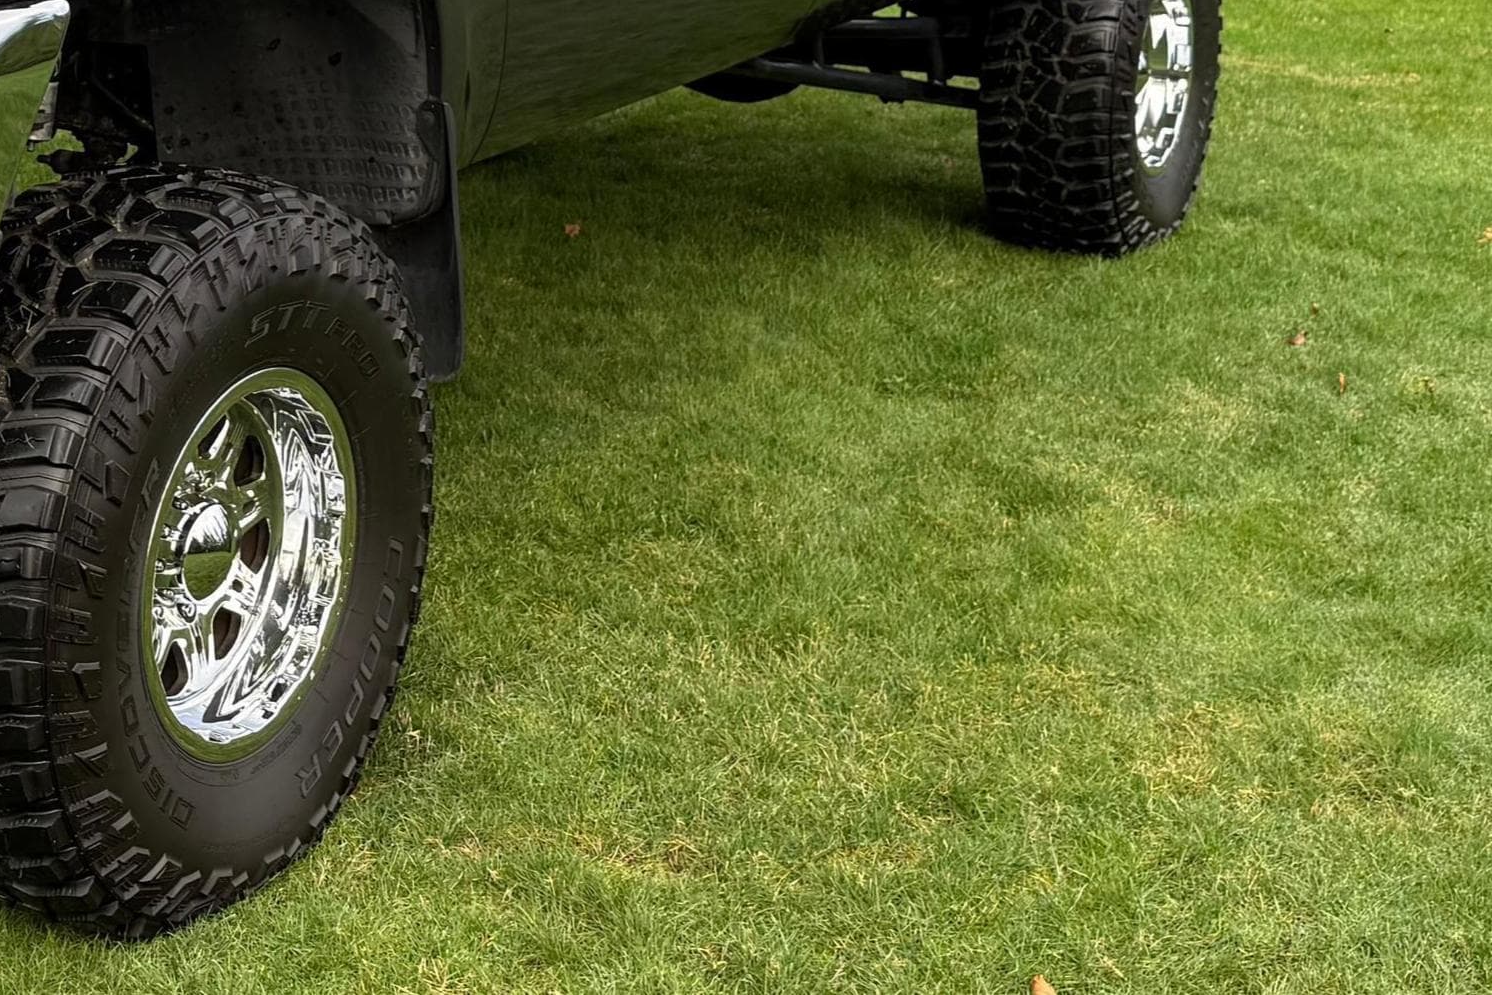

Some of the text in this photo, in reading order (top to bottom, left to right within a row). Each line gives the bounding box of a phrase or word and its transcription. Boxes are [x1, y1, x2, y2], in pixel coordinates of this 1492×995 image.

[243, 300, 381, 381] STT PRO
[294, 537, 404, 799] COOPER
